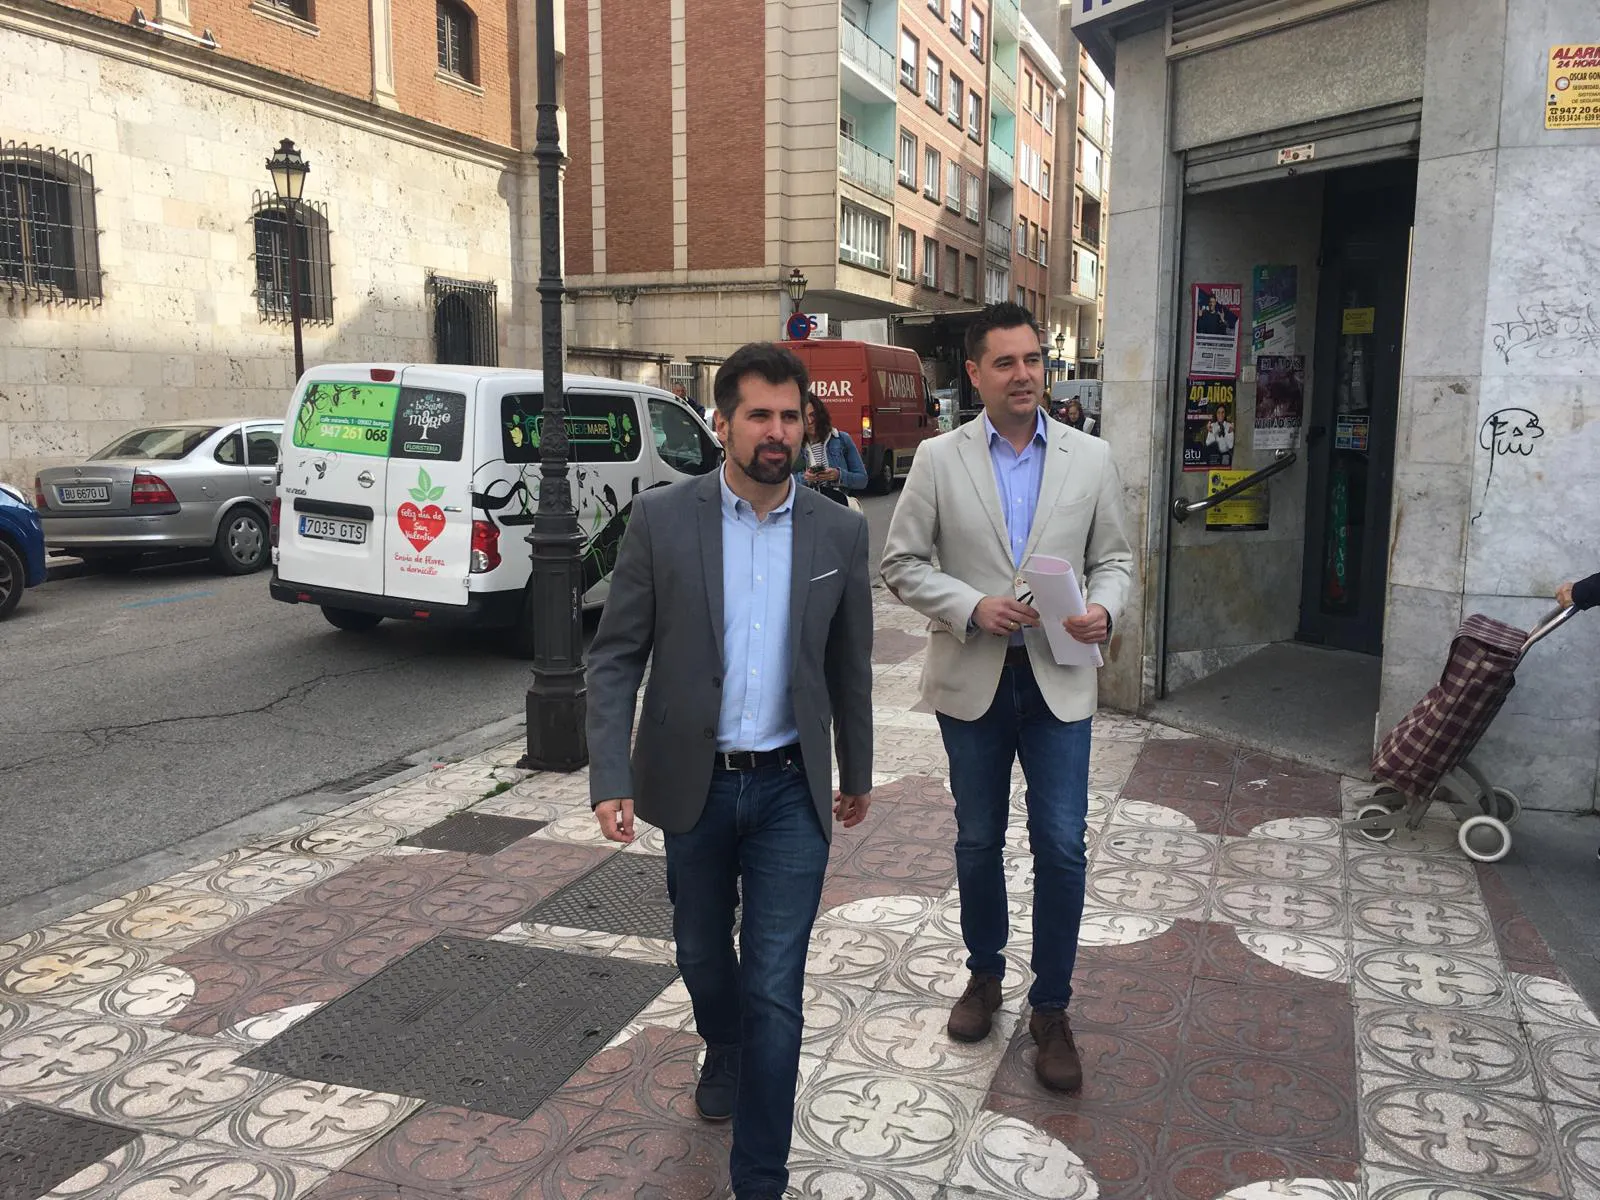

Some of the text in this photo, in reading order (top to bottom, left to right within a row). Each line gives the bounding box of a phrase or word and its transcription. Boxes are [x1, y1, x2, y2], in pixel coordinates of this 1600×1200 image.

[1556, 61, 1570, 69] 24
[1569, 72, 1588, 81] OSCAR
[1559, 107, 1577, 115] 947
[1579, 106, 1591, 114] 20
[807, 380, 854, 397] MBAR
[888, 373, 917, 399] AMBAR
[1207, 382, 1234, 403] AÑOS
[320, 425, 388, 442] 947 261 068
[65, 488, 105, 500] BU 6670 U
[432, 511, 443, 521] de
[307, 519, 363, 540] 7035 GTS
[413, 522, 429, 532] San
[414, 554, 423, 563] de
